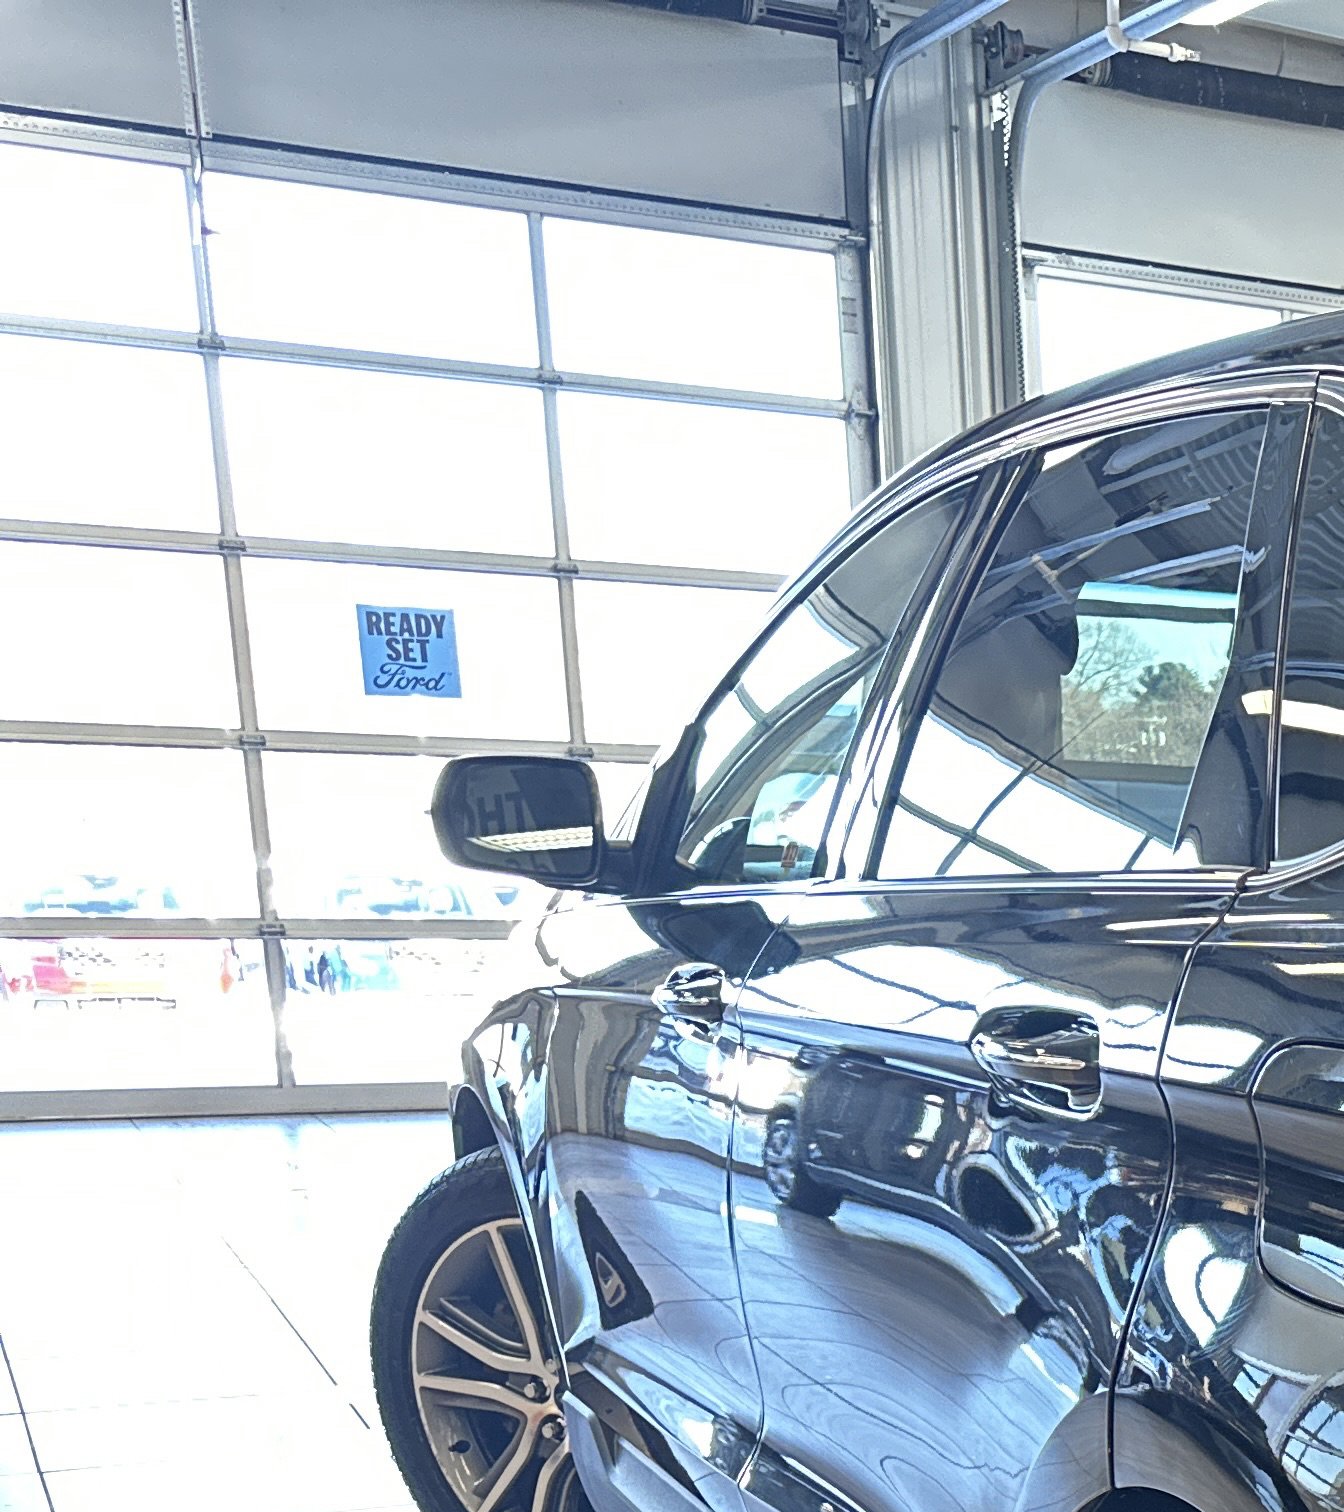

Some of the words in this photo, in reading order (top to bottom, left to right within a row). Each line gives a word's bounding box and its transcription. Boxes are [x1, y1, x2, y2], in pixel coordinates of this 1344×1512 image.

[365, 611, 446, 638] READY
[385, 637, 430, 663] SET
[373, 662, 446, 691] Ford
